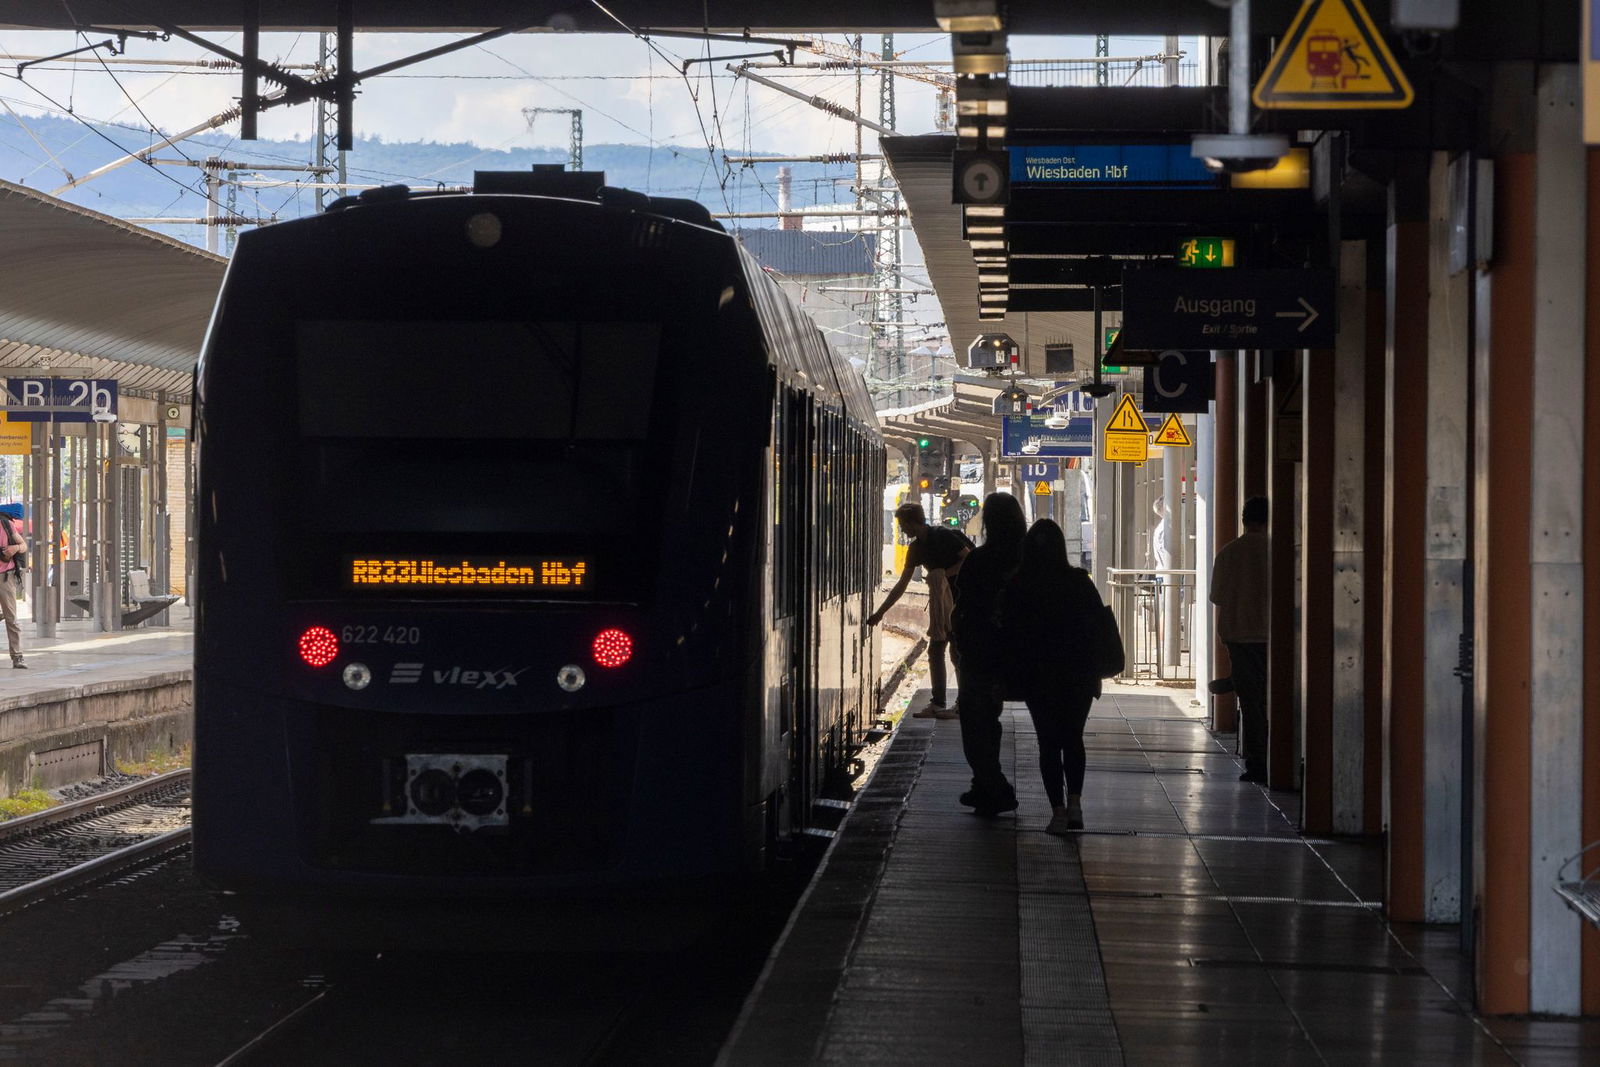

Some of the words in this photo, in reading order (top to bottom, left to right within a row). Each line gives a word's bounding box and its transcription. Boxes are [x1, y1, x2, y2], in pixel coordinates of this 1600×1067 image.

[1025, 156, 1061, 165] Wiesbaden
[1062, 156, 1076, 165] Ost
[1026, 165, 1101, 180] Wiesbaden
[1104, 164, 1128, 180] Hbf
[1173, 295, 1257, 318] Ausgang
[1201, 323, 1221, 335] Exit
[1230, 323, 1259, 336] Sortie
[1151, 350, 1188, 399] C
[68, 380, 112, 413] 2b
[541, 561, 587, 586] Hbf
[341, 625, 379, 645] 622
[382, 626, 421, 646] 420
[432, 665, 533, 690] vlexx
